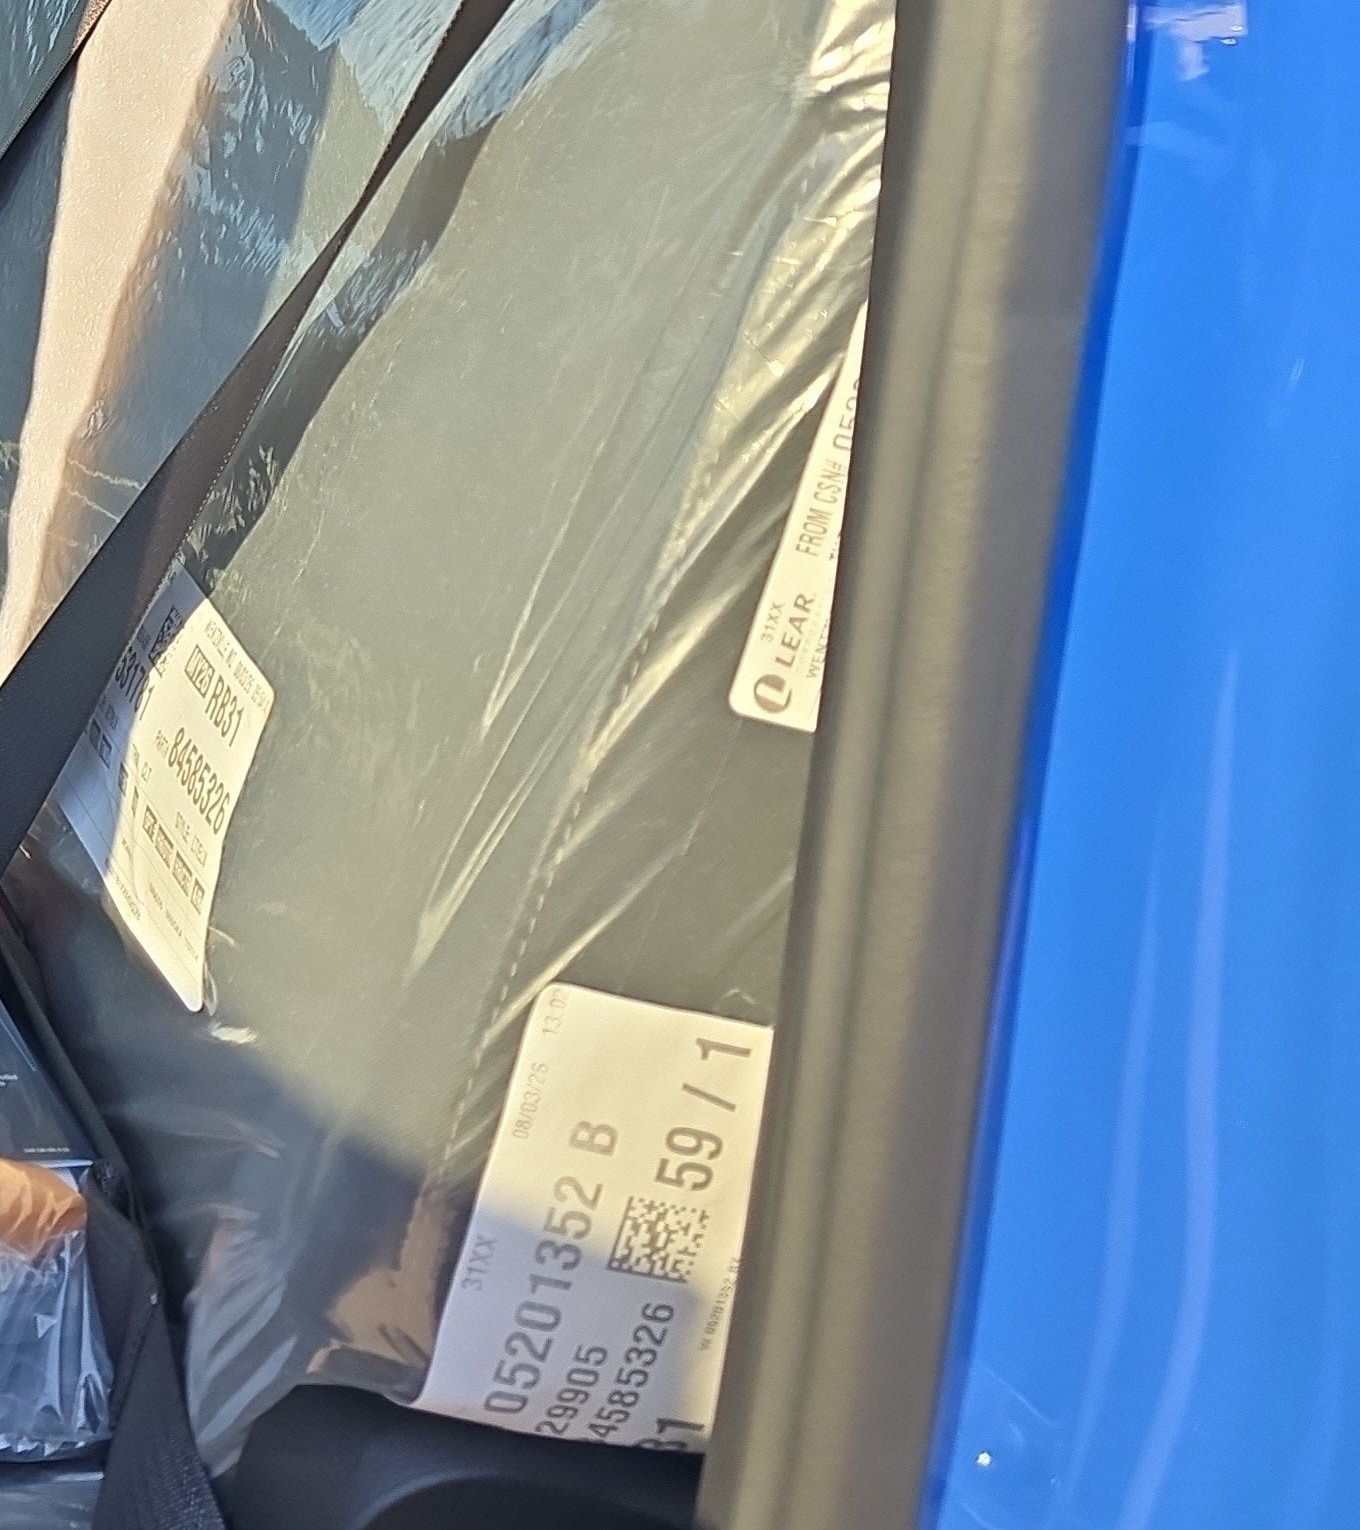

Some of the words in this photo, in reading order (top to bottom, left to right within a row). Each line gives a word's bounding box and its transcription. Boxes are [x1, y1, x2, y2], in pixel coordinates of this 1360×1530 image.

[795, 507, 832, 558] FROM
[774, 591, 816, 668] LEAR
[204, 674, 245, 748] RB31
[167, 726, 231, 835] 84585326
[654, 1124, 724, 1194] 59
[695, 1035, 753, 1061] 1
[460, 1234, 498, 1292] 31XX
[484, 1174, 605, 1414] 05201352
[568, 1117, 619, 1158] B
[533, 1344, 608, 1435] 29905
[584, 1300, 675, 1440] 4585326
